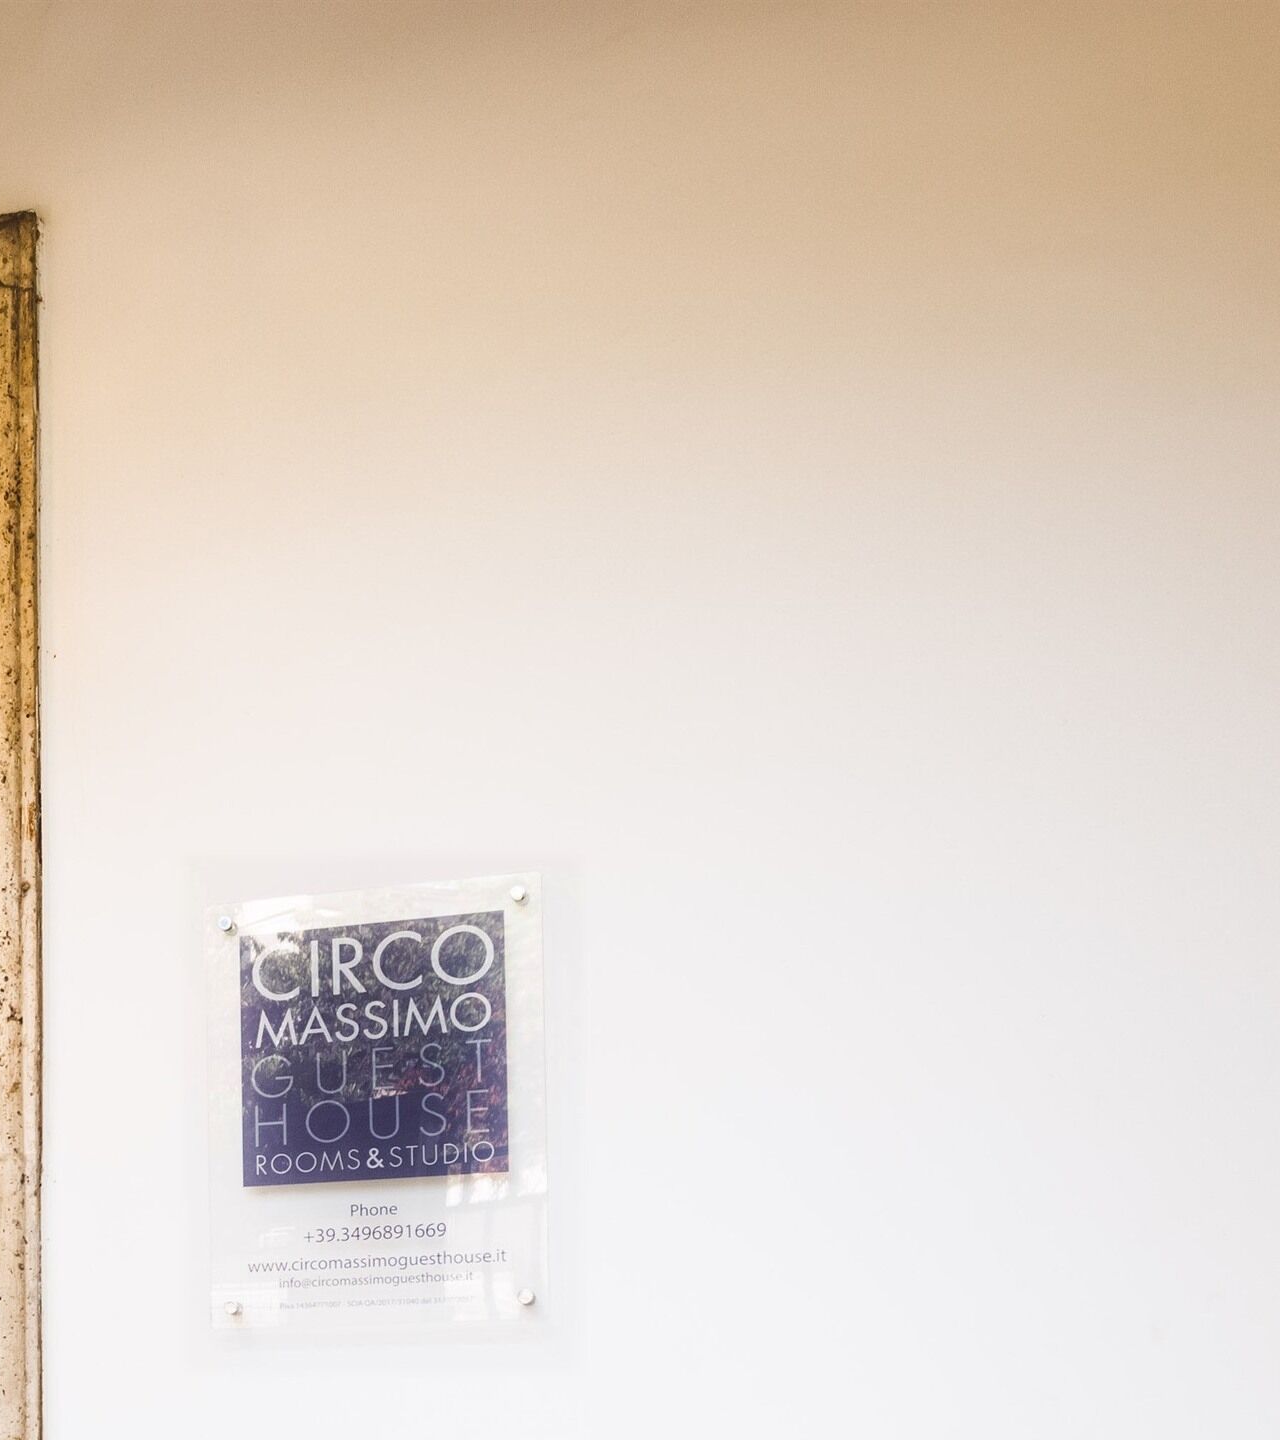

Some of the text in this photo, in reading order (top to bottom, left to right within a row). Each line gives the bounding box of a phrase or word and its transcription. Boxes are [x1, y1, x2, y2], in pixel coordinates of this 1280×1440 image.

[251, 924, 495, 1001] CIRCO
[255, 992, 492, 1049] MASSIMO
[251, 1038, 492, 1098] GUEST
[254, 1089, 490, 1148] HOUSE
[350, 1203, 398, 1217] Phone
[304, 1222, 447, 1243] +39.3496891669
[247, 1249, 508, 1274] www.circomassimoguesthouse.it
[279, 1271, 474, 1289] info@circomassimoguesthouse.it
